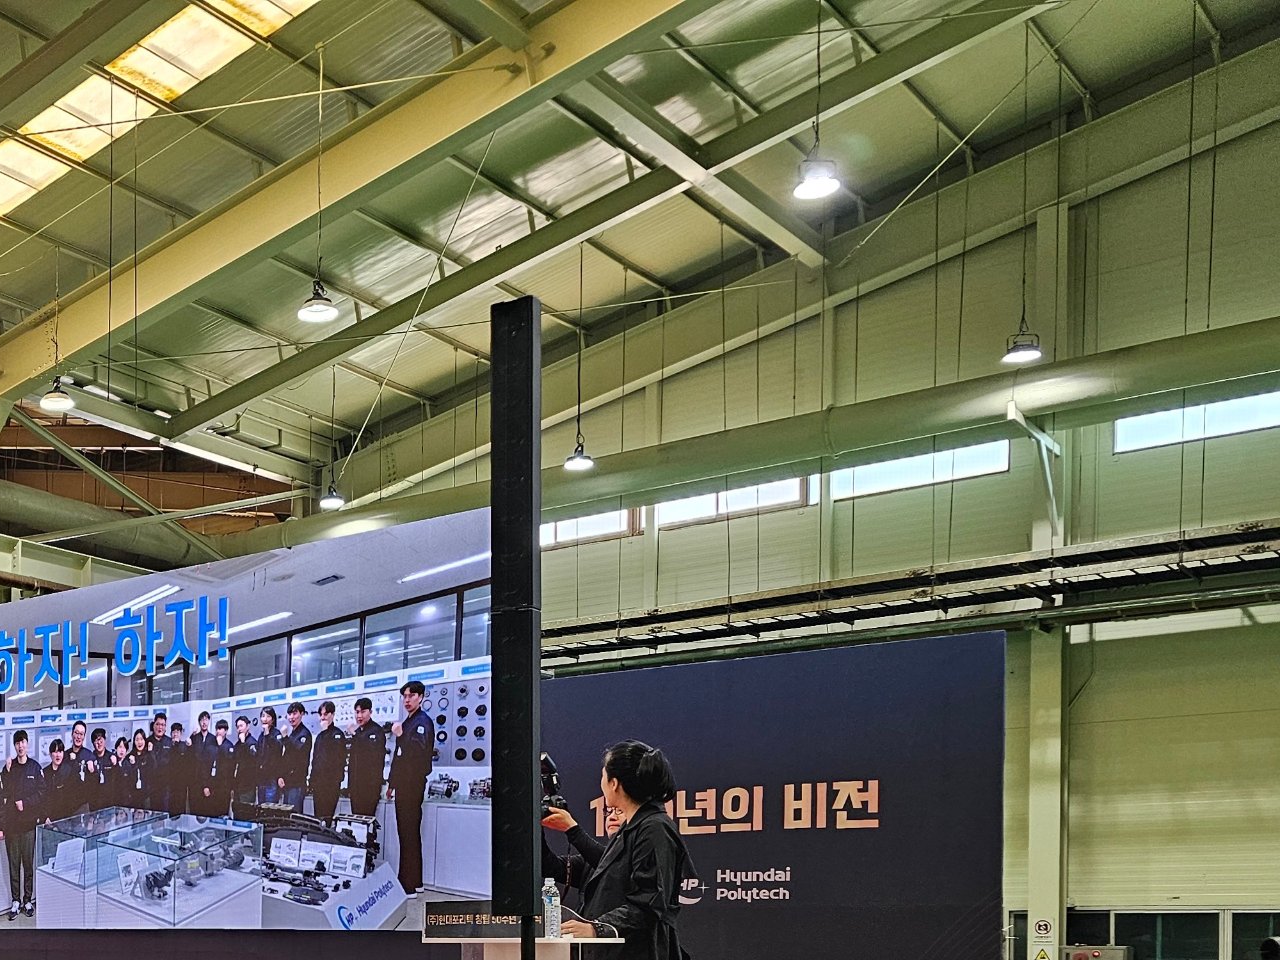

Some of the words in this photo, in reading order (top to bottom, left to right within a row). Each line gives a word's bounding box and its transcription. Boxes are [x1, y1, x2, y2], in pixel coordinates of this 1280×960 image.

[113, 595, 229, 676] 하자!
[590, 790, 763, 837] 1년의
[783, 779, 880, 830] 비전
[716, 866, 791, 886] Hyundai
[716, 887, 790, 903] Polytech
